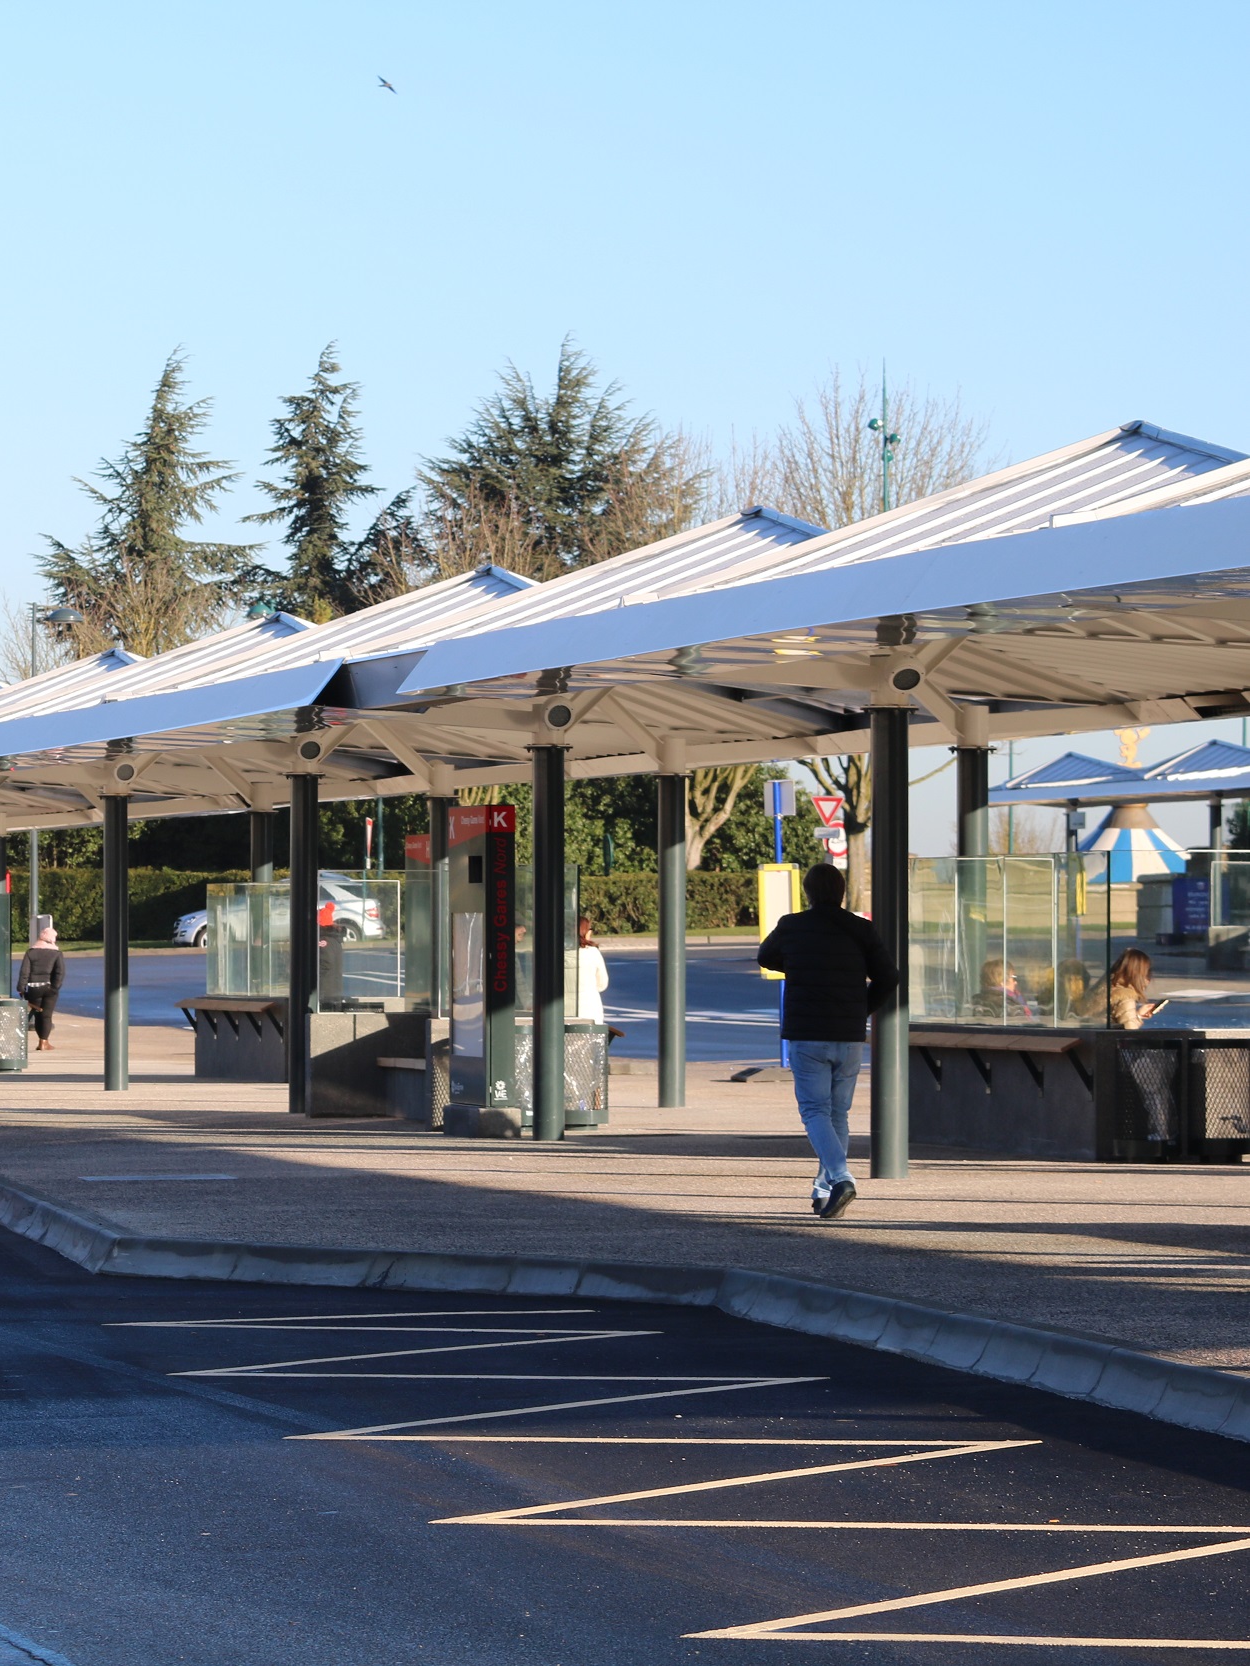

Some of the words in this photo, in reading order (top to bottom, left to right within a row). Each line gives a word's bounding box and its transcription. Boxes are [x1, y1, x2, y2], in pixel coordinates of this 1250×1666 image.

[449, 816, 455, 839] K
[493, 811, 508, 828] K
[494, 837, 508, 875] Nord
[494, 879, 508, 927] Gares
[493, 932, 510, 992] Chessy
